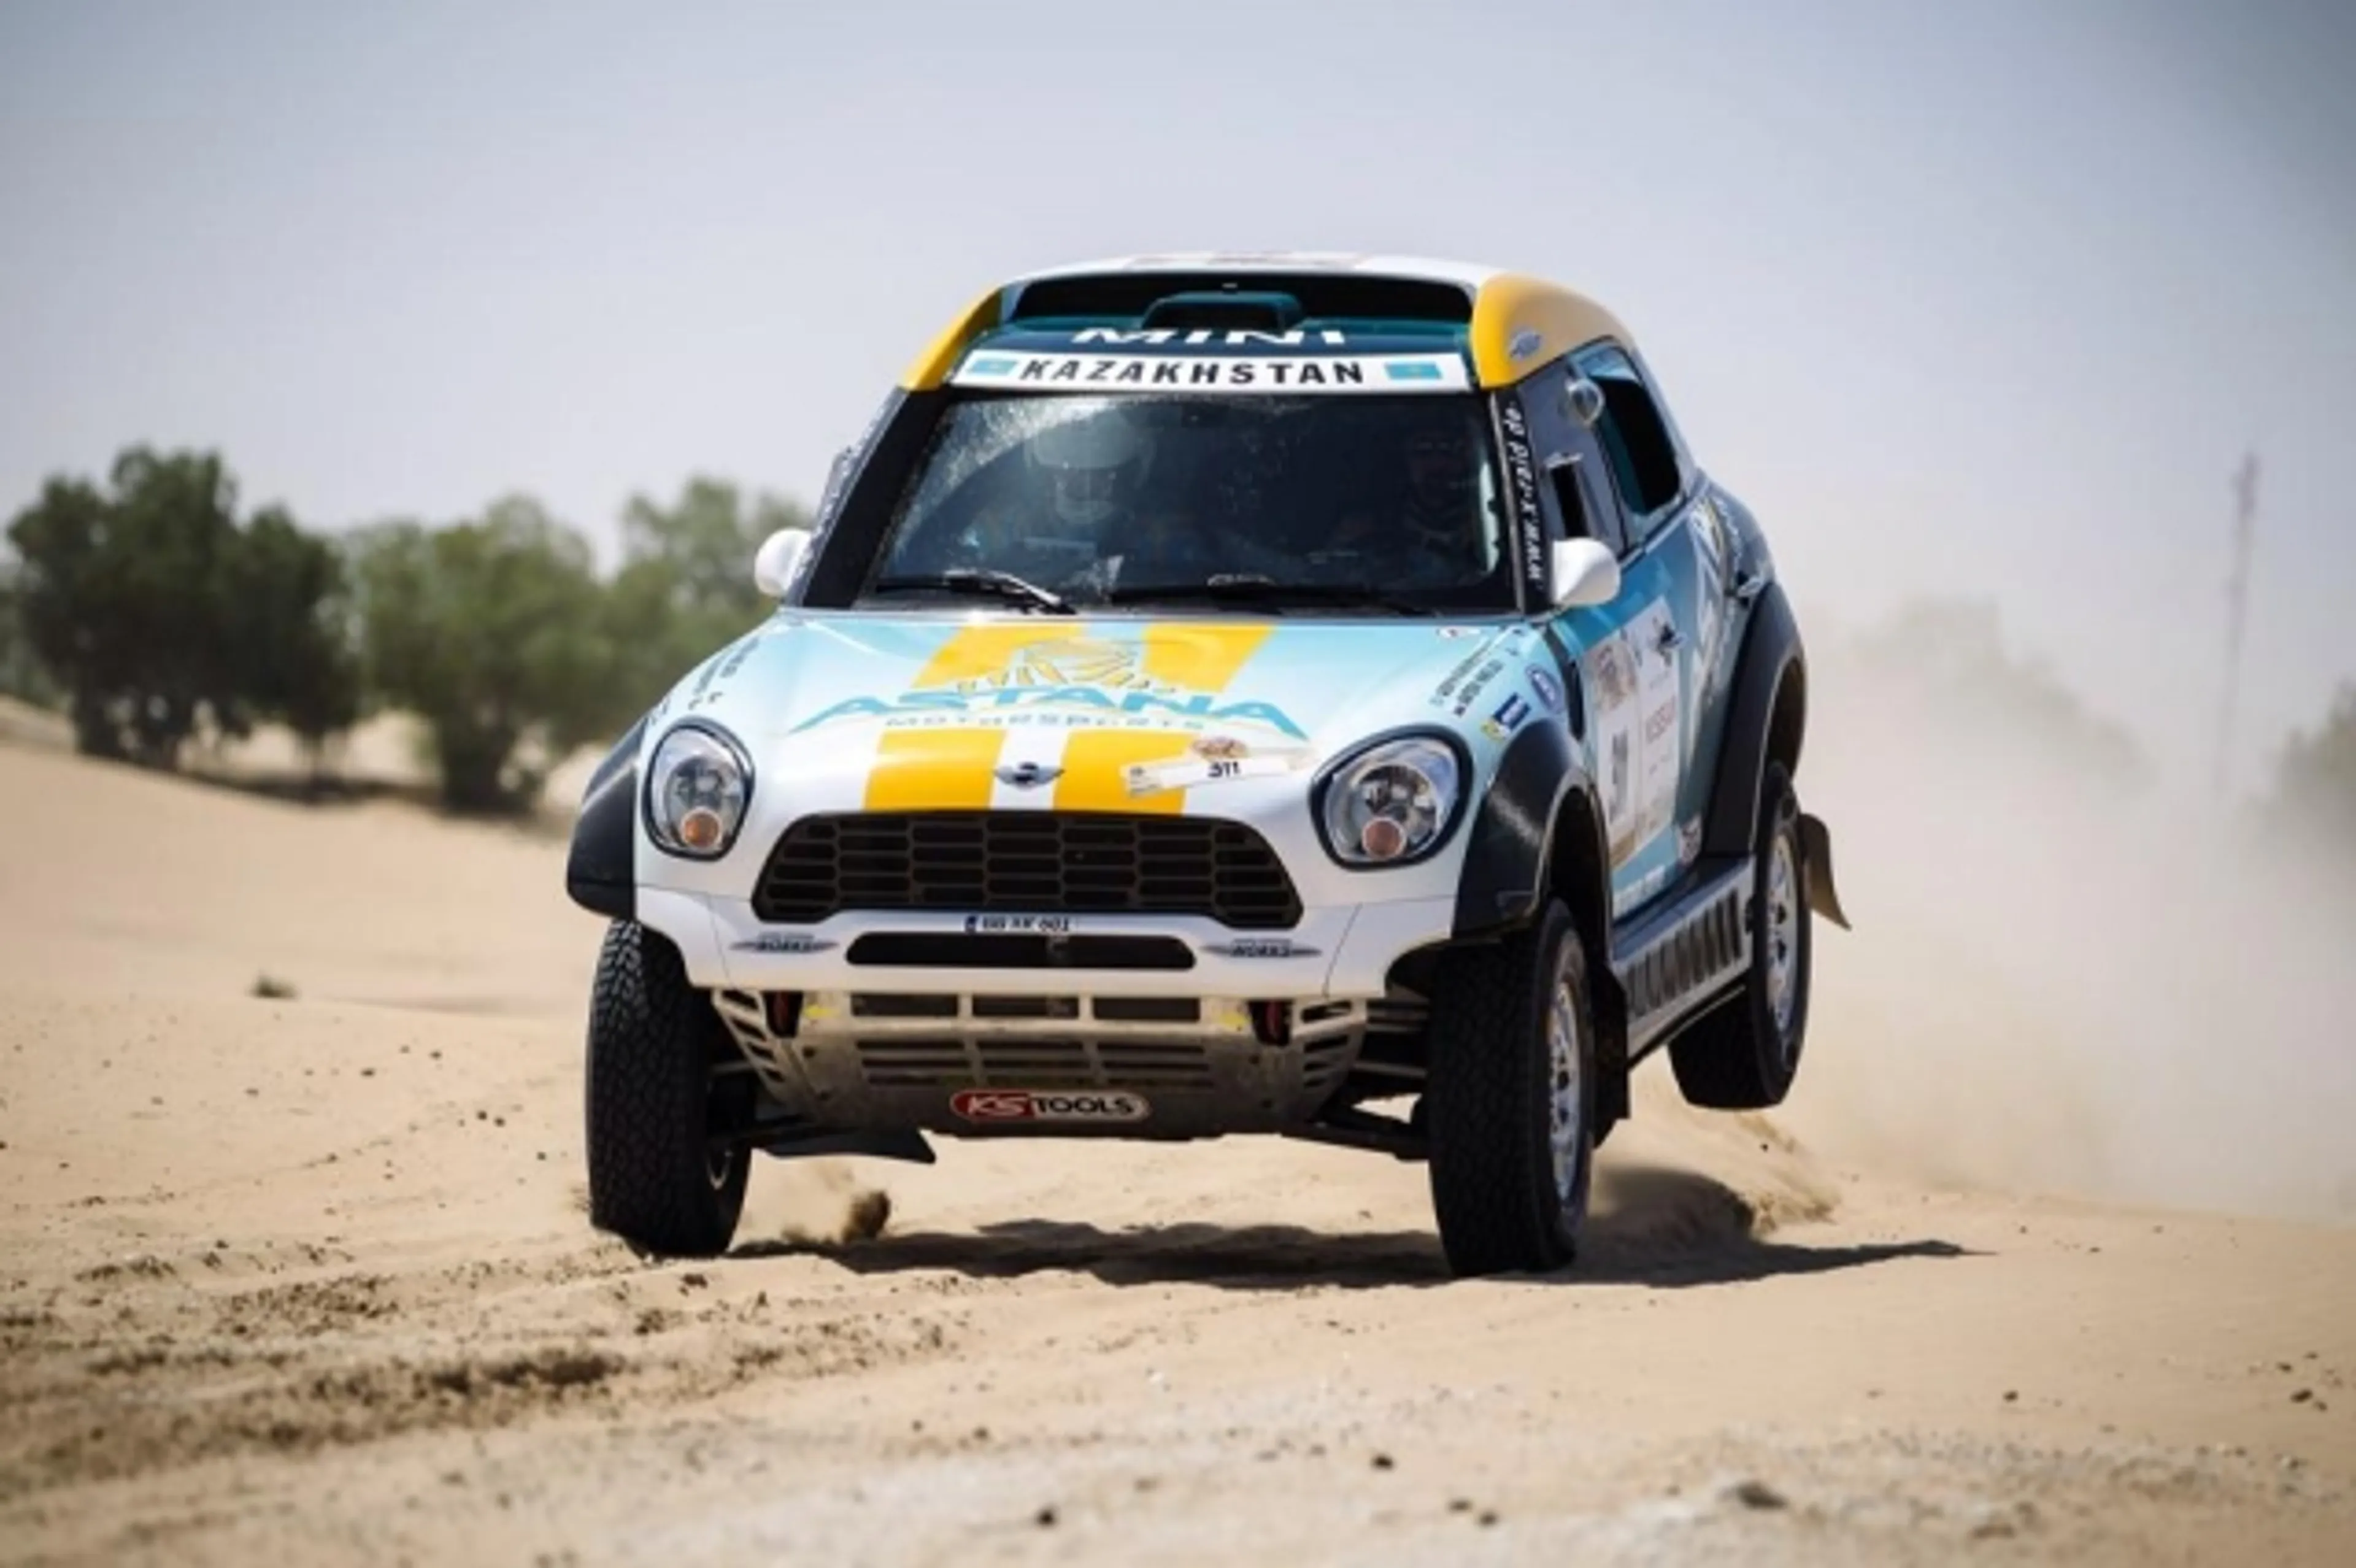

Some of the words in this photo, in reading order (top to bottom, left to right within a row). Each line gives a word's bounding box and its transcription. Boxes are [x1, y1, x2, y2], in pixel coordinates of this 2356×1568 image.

[1072, 327, 1345, 344] MINI
[1018, 359, 1365, 385] KAZAKHSTAN
[789, 686, 1307, 741] ASTANA
[1207, 761, 1241, 778] 311
[968, 1095, 1026, 1118] KS
[1032, 1096, 1135, 1114] TOOLS
